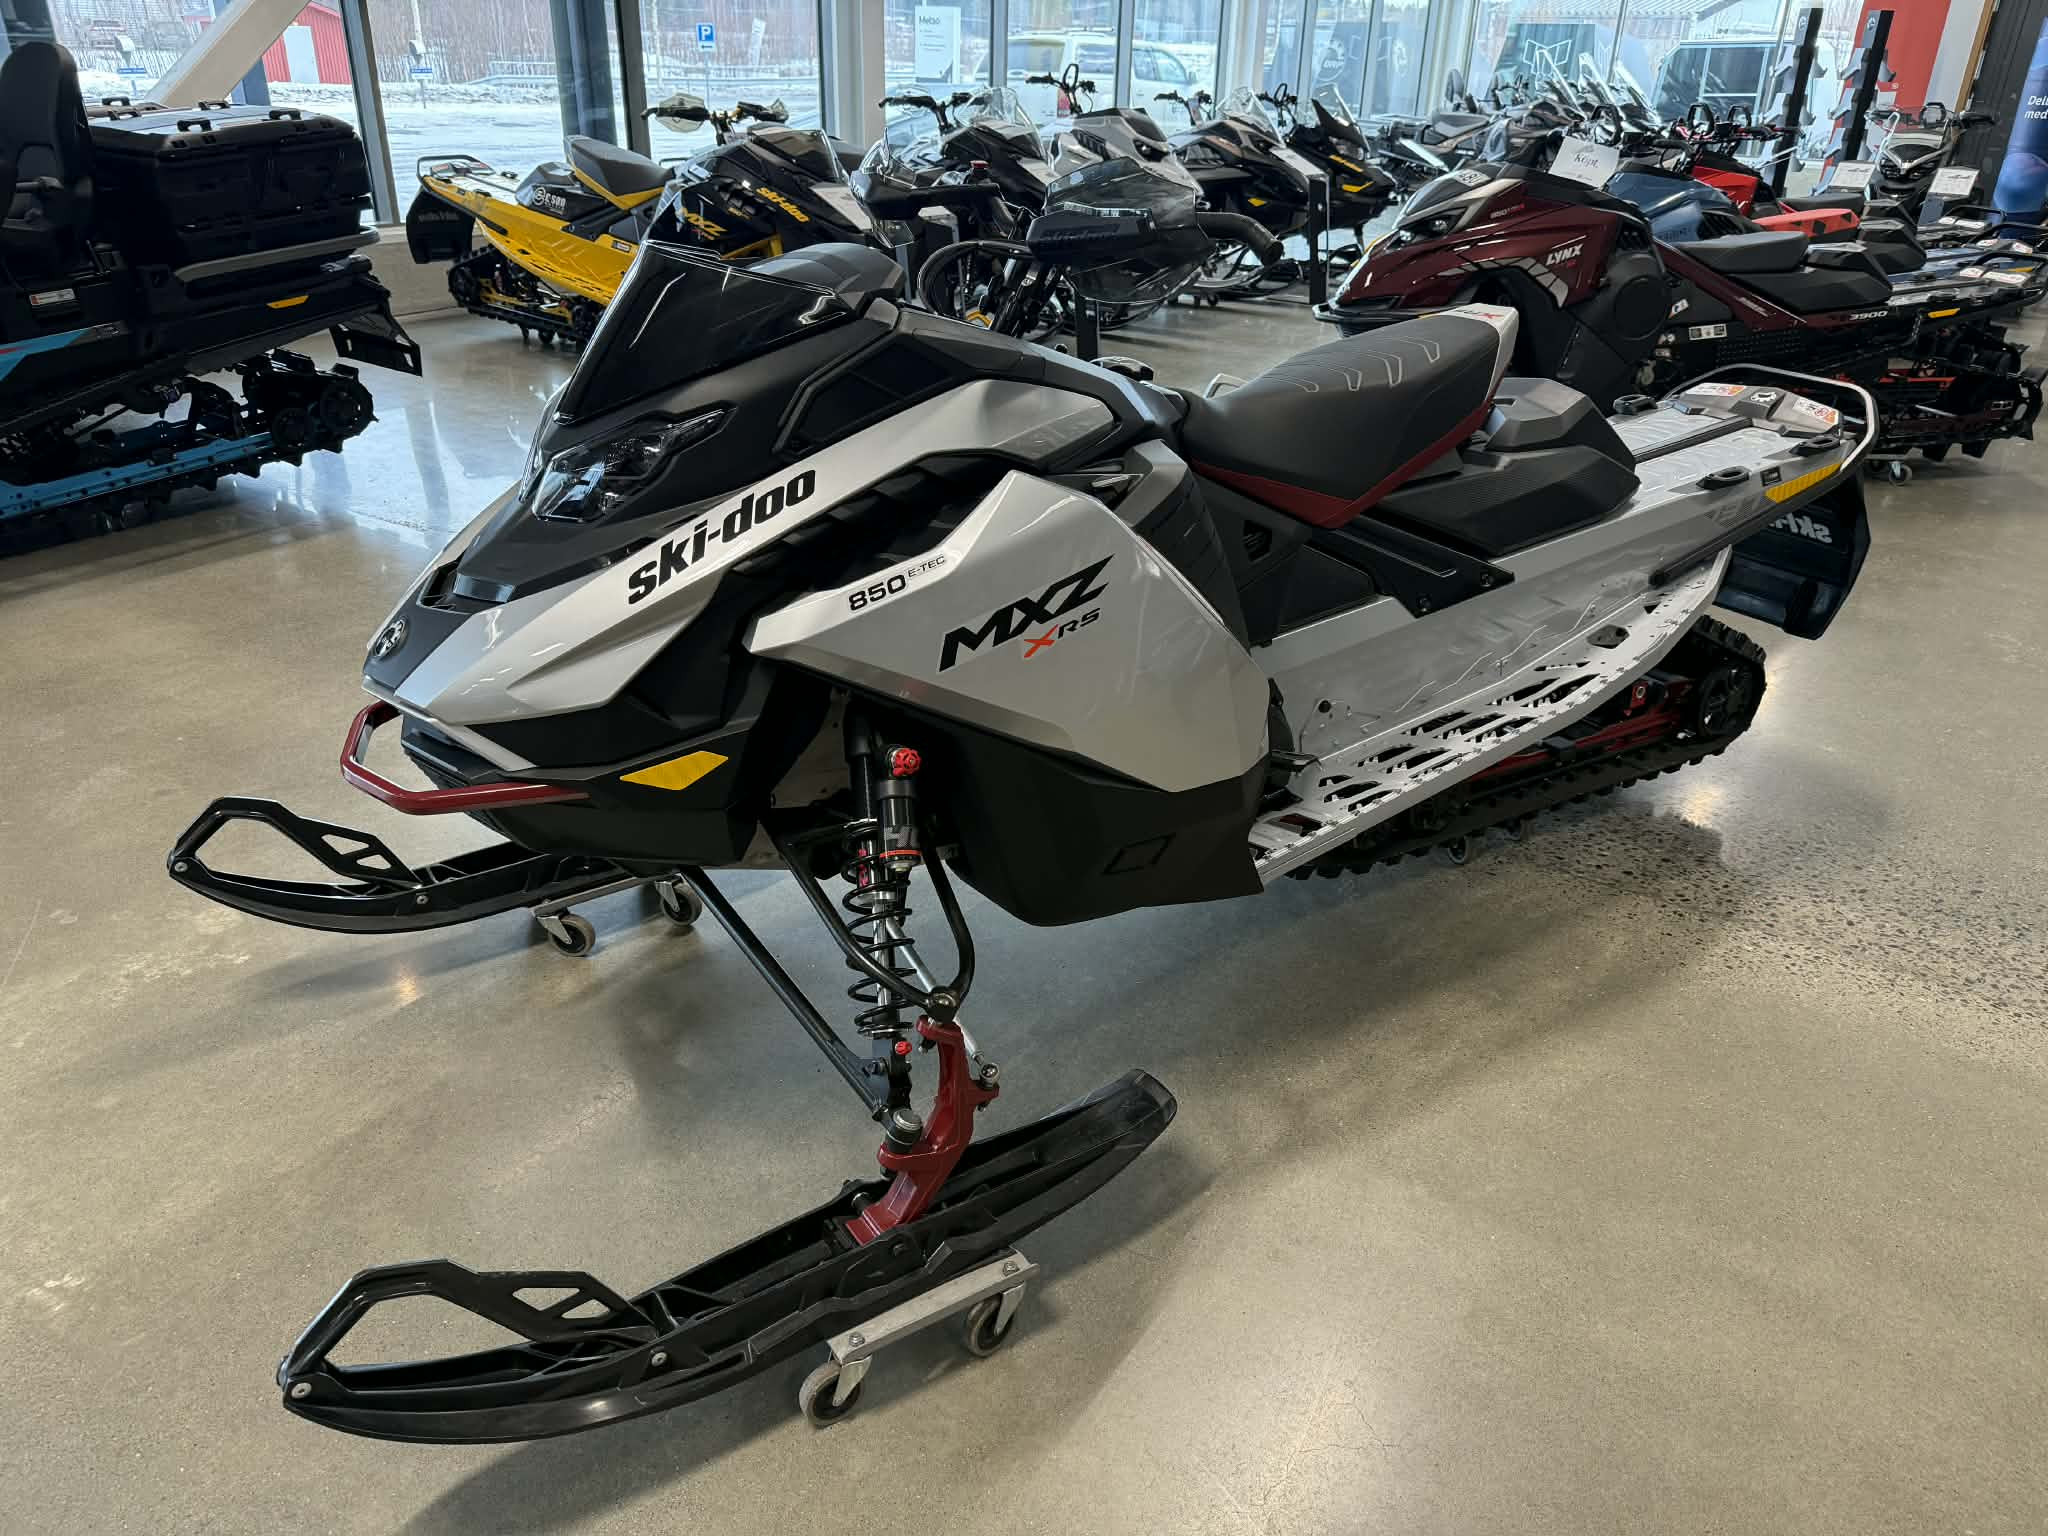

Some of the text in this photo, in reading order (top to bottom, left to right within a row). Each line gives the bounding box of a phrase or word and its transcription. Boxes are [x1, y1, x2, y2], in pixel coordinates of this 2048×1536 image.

[701, 26, 712, 41] P
[1546, 244, 1584, 266] LYNX
[1849, 310, 1889, 321] 3900
[628, 469, 816, 605] ski-doo
[848, 555, 945, 611] 850 E-TEC
[939, 553, 1116, 672] MXZ
